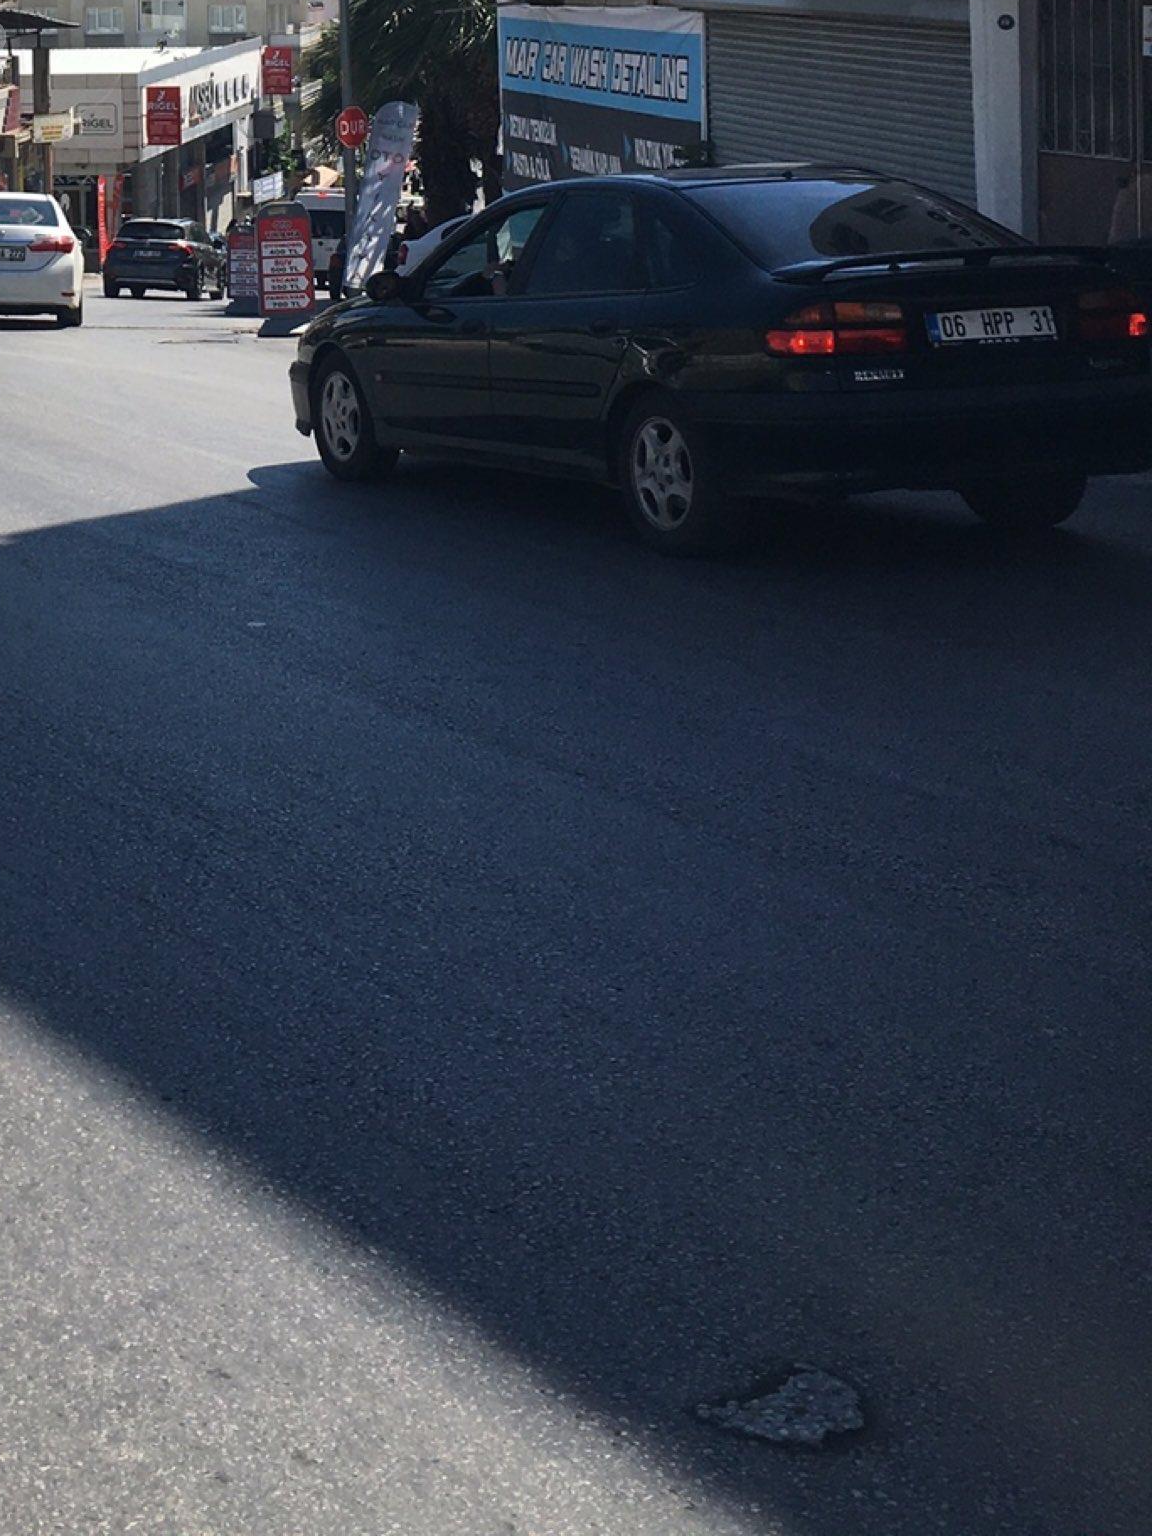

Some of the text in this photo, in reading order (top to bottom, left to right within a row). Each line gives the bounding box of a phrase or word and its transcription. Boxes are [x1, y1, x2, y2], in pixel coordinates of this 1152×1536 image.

[541, 41, 568, 84] CAR
[570, 44, 610, 91] WASH
[610, 49, 689, 102] DETAILING
[339, 119, 366, 136] DUR
[941, 309, 1054, 338] 06 HPP 31
